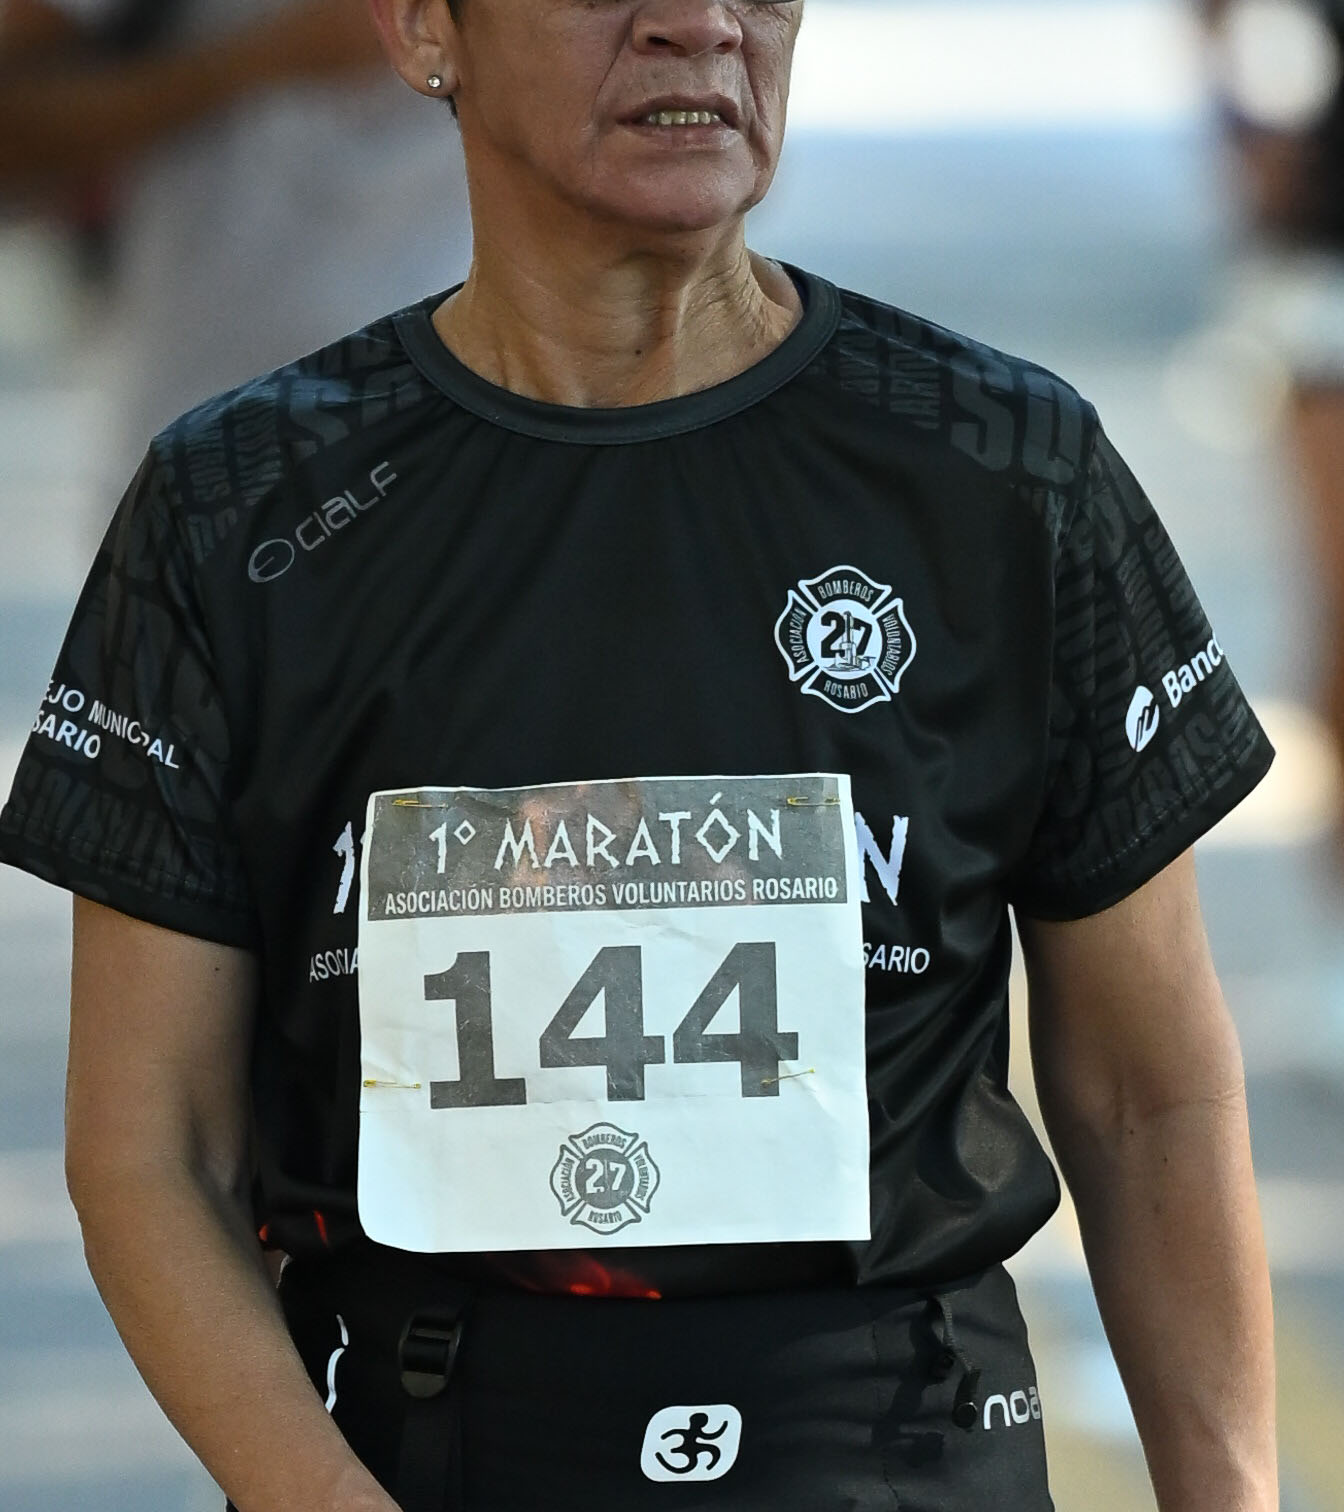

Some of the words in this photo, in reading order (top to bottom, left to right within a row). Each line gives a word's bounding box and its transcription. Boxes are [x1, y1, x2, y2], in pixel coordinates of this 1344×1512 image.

[817, 579, 874, 602] BOMBEROS
[821, 610, 873, 659] 27
[824, 679, 869, 700] ROSARIO
[494, 791, 784, 871] MARATÓN
[500, 884, 607, 909] BOMBEROS
[613, 878, 746, 905] VOLUNTARIOS
[753, 876, 838, 900] ROSARIO
[424, 941, 799, 1109] 144
[585, 1158, 627, 1194] 27
